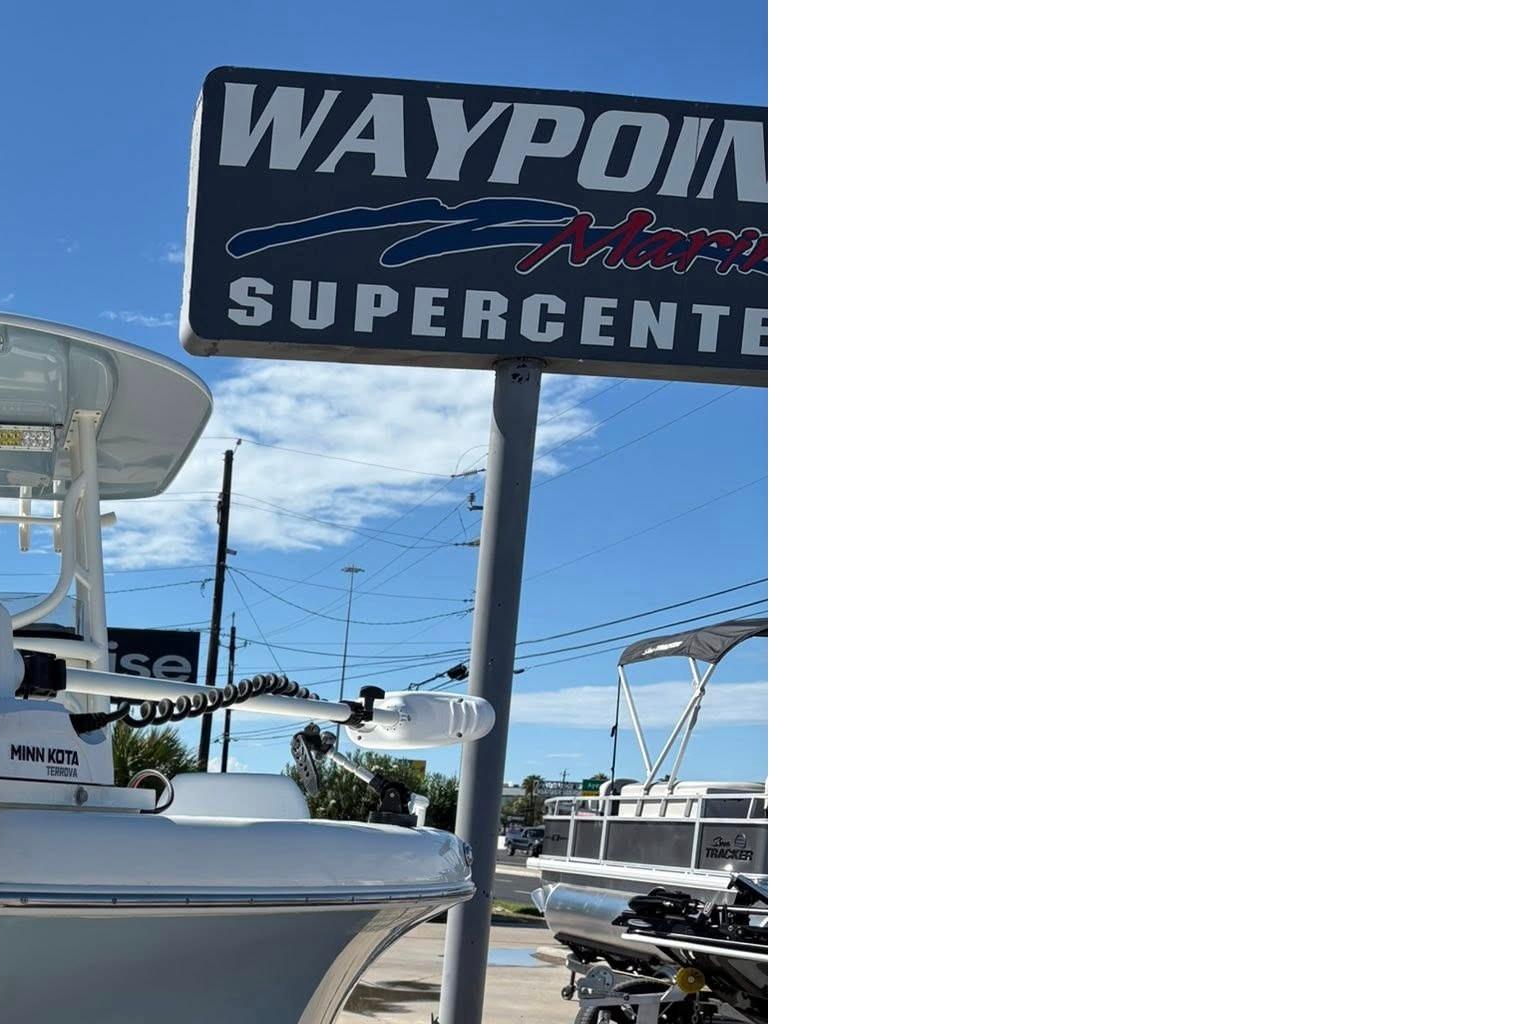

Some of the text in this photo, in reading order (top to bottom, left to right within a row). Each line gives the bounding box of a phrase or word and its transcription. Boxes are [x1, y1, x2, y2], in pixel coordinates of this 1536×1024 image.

[227, 277, 768, 356] SUPERCENTE
[10, 744, 79, 766] MINN KOTA
[46, 766, 78, 778] TERROVA
[705, 847, 754, 861] TRACKER
